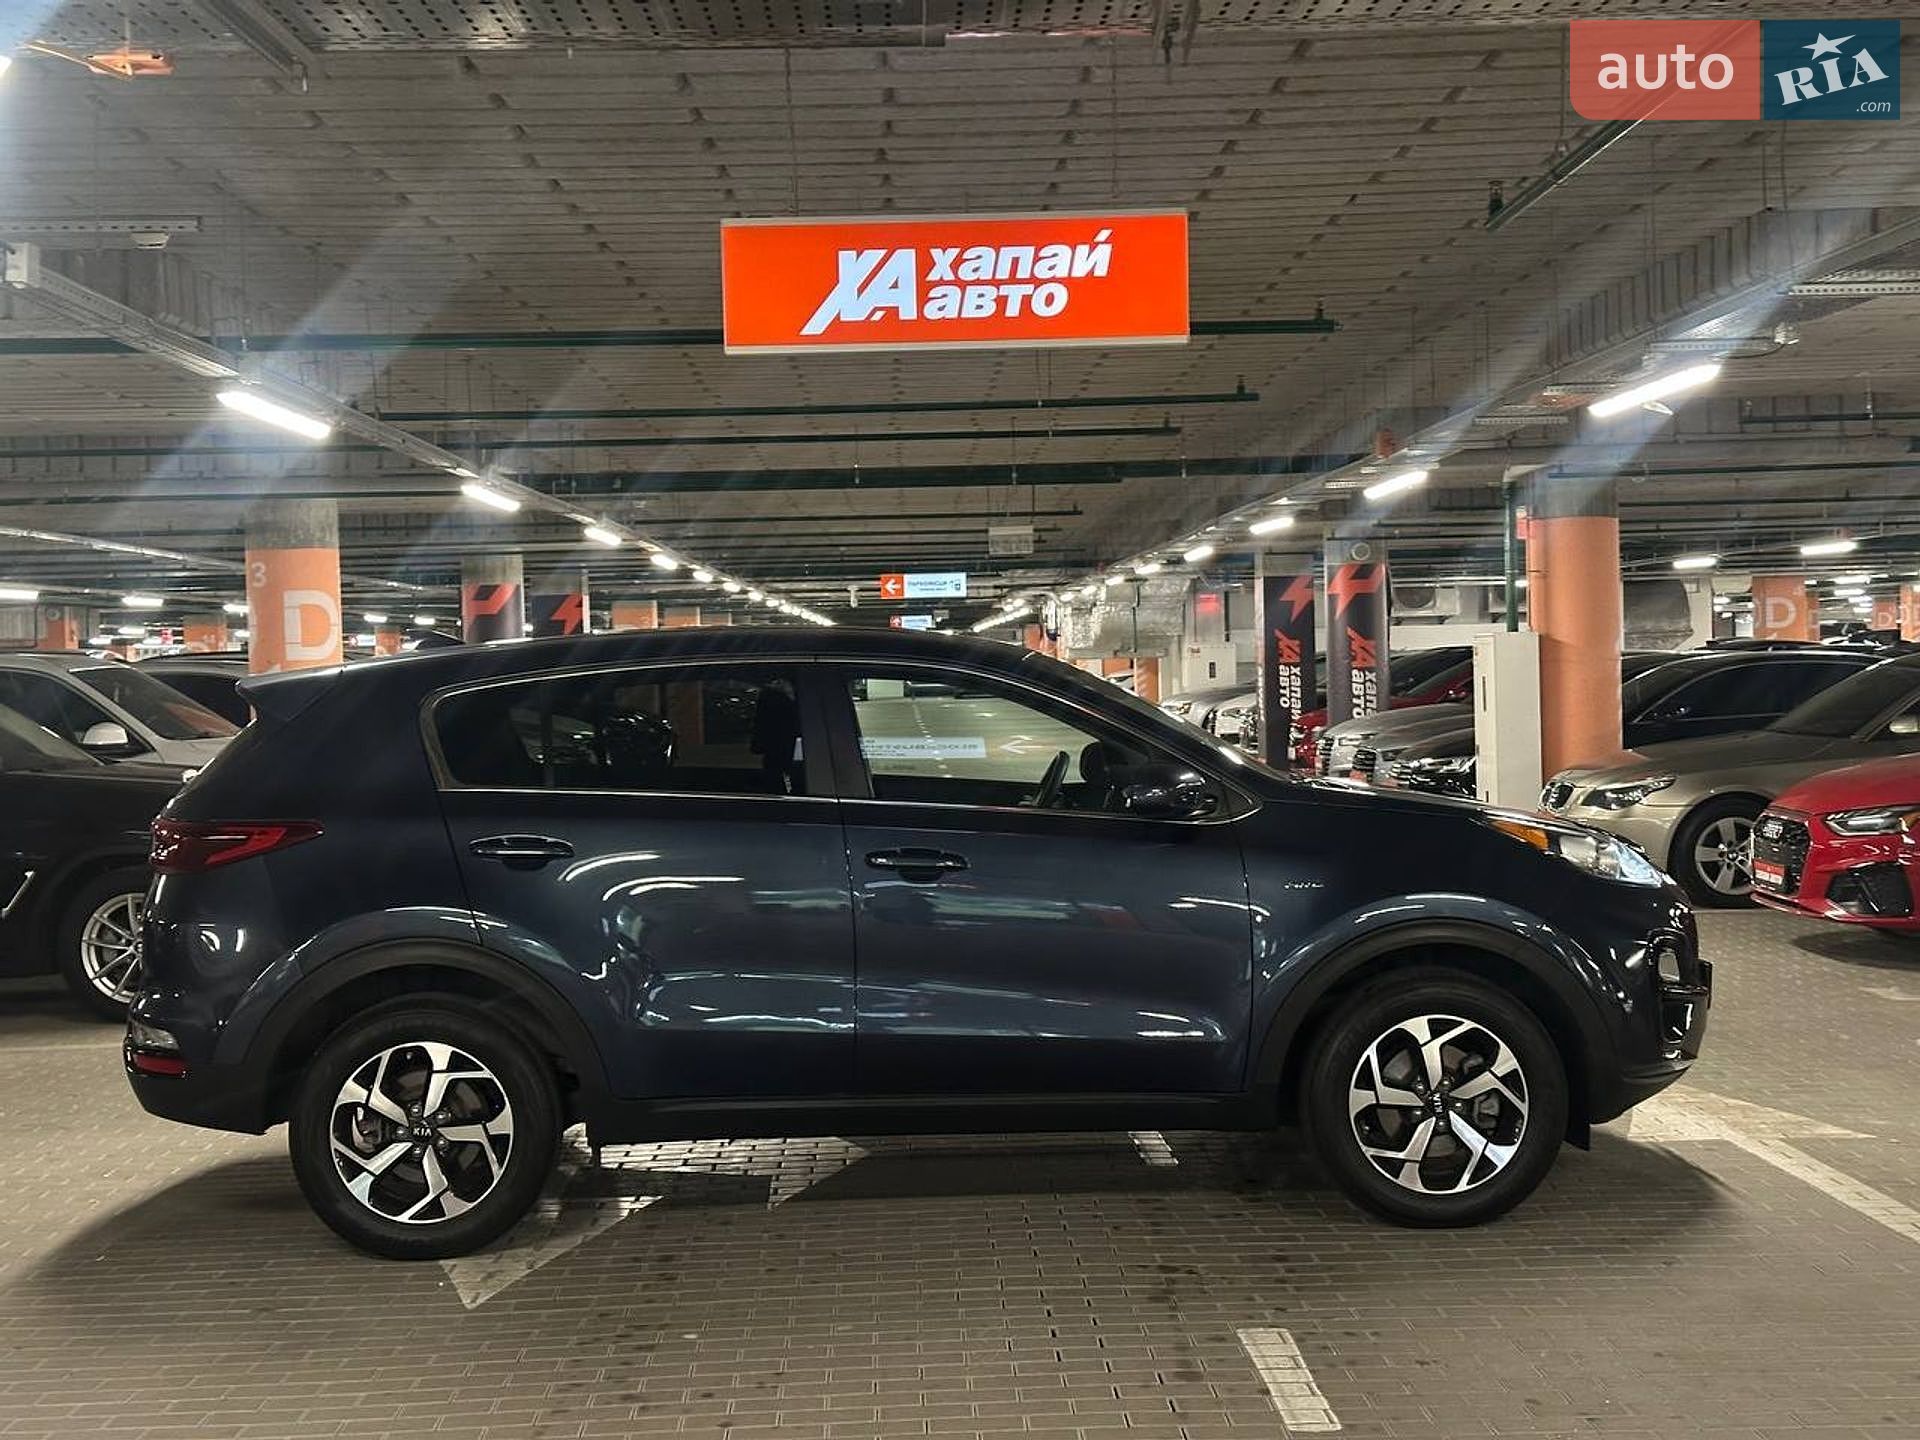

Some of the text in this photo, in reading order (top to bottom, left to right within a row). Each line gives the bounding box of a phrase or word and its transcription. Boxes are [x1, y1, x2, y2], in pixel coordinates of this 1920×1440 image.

[923, 283, 1069, 320] авто
[283, 590, 338, 661] D
[1766, 597, 1797, 629] D
